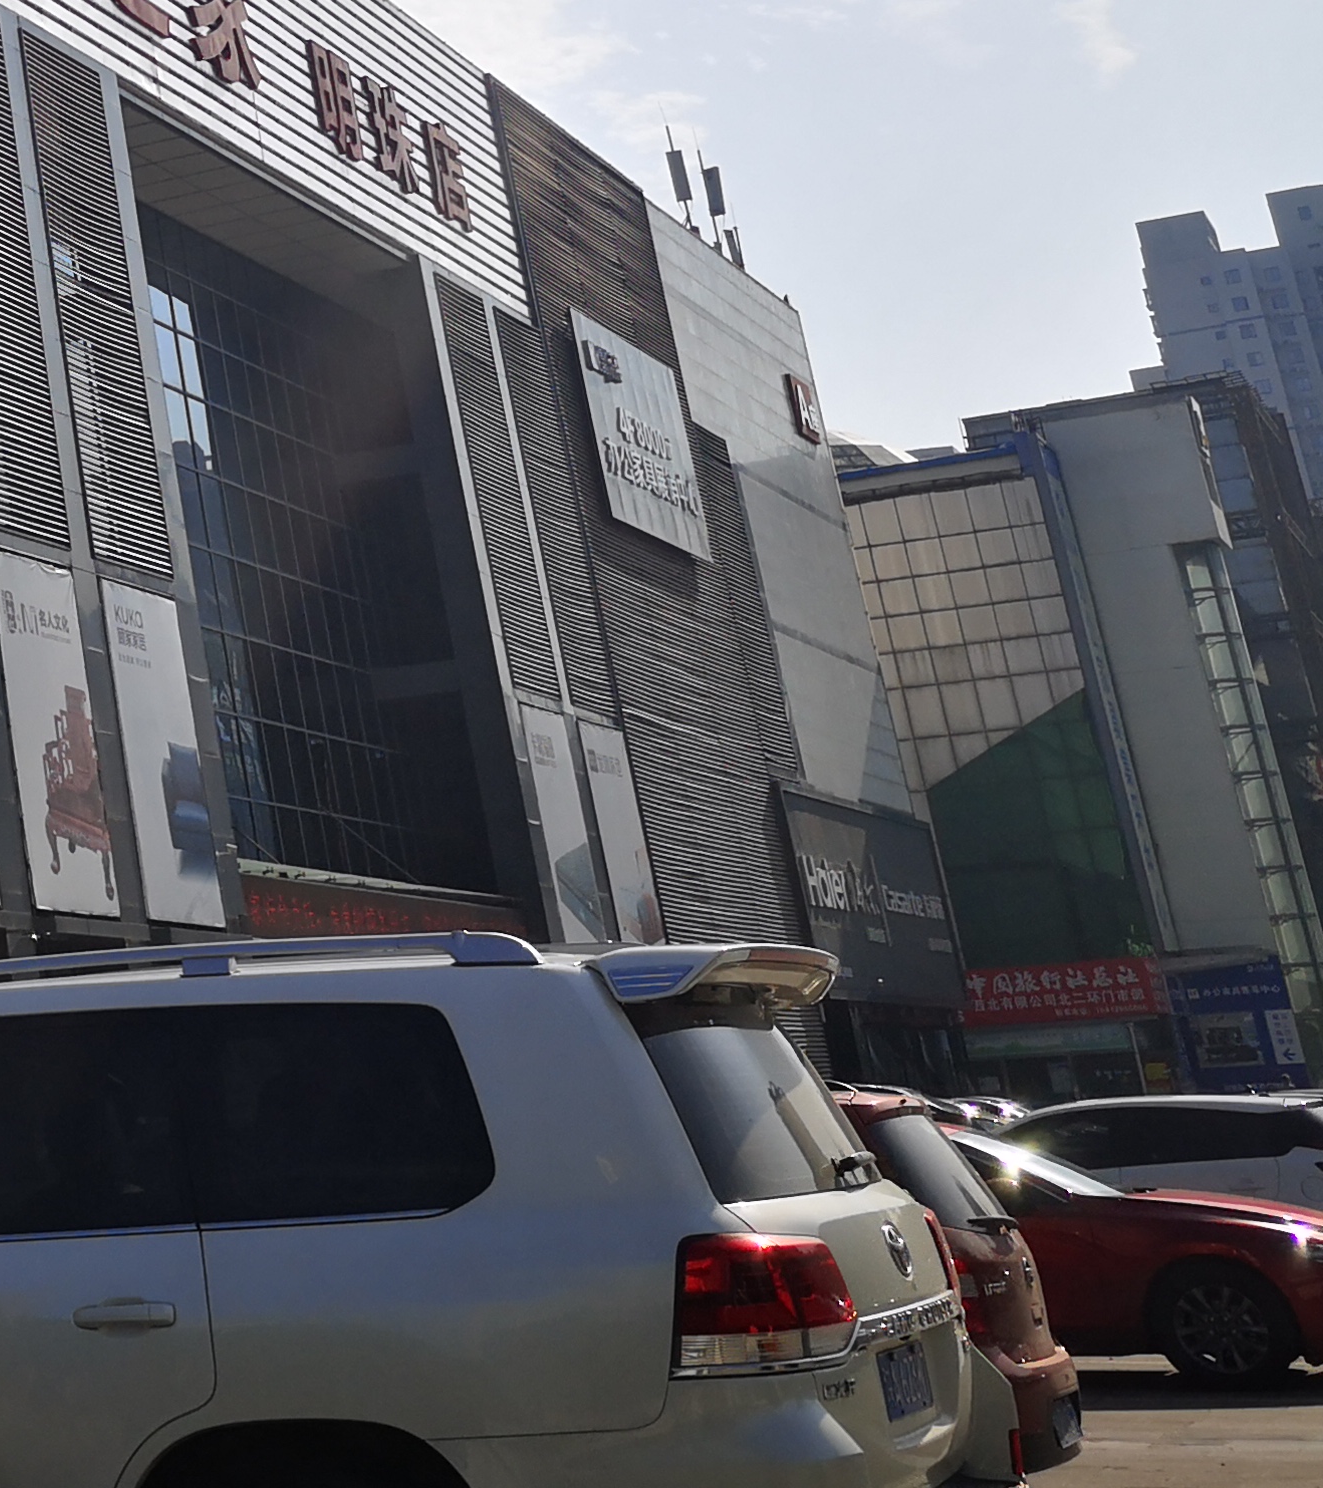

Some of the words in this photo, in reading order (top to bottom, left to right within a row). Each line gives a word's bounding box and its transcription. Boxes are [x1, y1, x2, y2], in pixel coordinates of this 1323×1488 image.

[306, 39, 472, 232] 明珠店
[802, 854, 850, 912] Haier
[966, 965, 1140, 999] 中国旅行社总社
